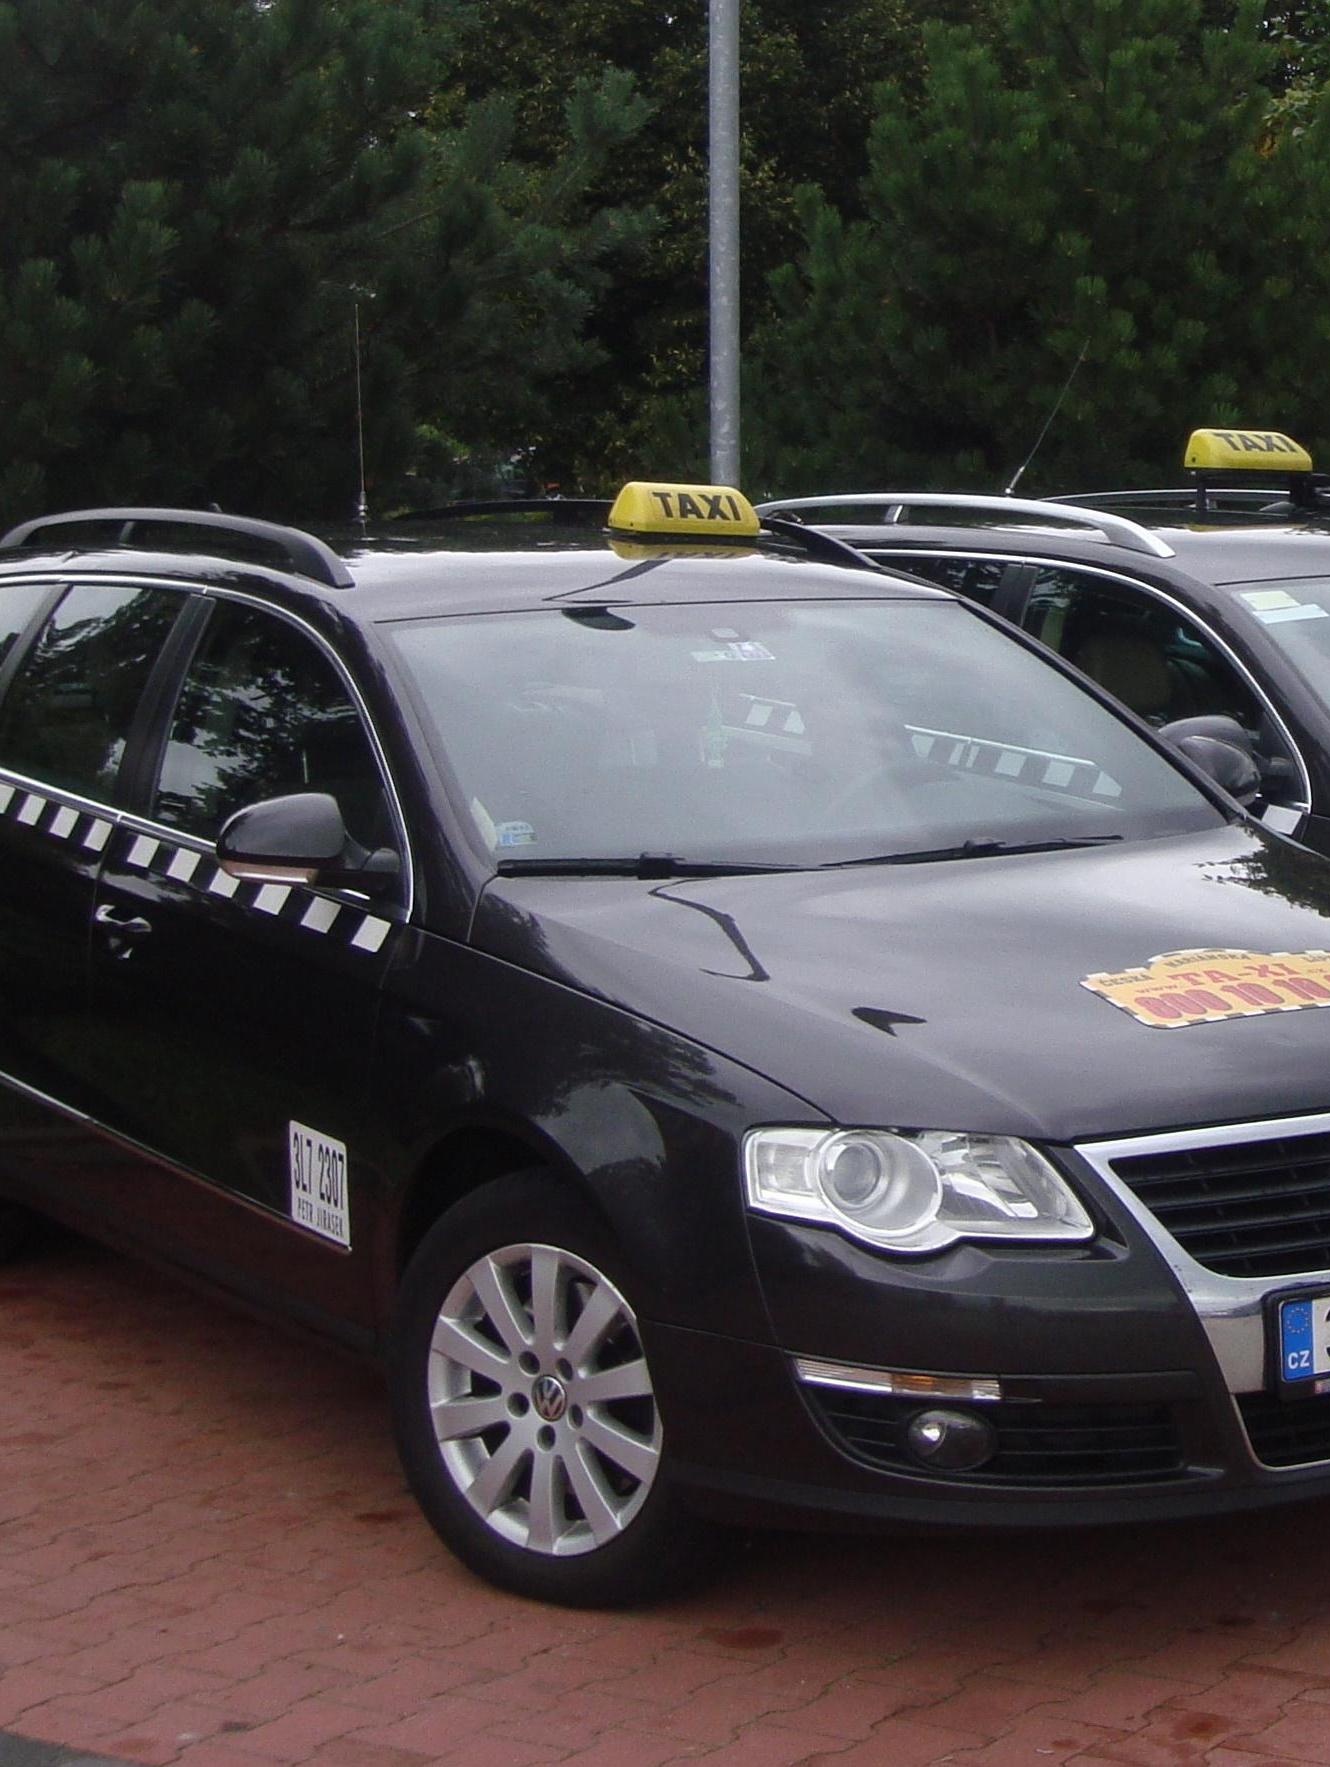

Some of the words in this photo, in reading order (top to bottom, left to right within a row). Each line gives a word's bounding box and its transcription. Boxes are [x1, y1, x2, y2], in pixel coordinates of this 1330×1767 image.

[1213, 432, 1299, 453] TAXI
[652, 491, 742, 521] TAXI
[1166, 963, 1302, 986] TA-XI
[1219, 981, 1286, 1006] 10
[293, 1131, 313, 1195] 3L7
[318, 1143, 344, 1211] 2307
[1287, 1350, 1310, 1371] CZ
